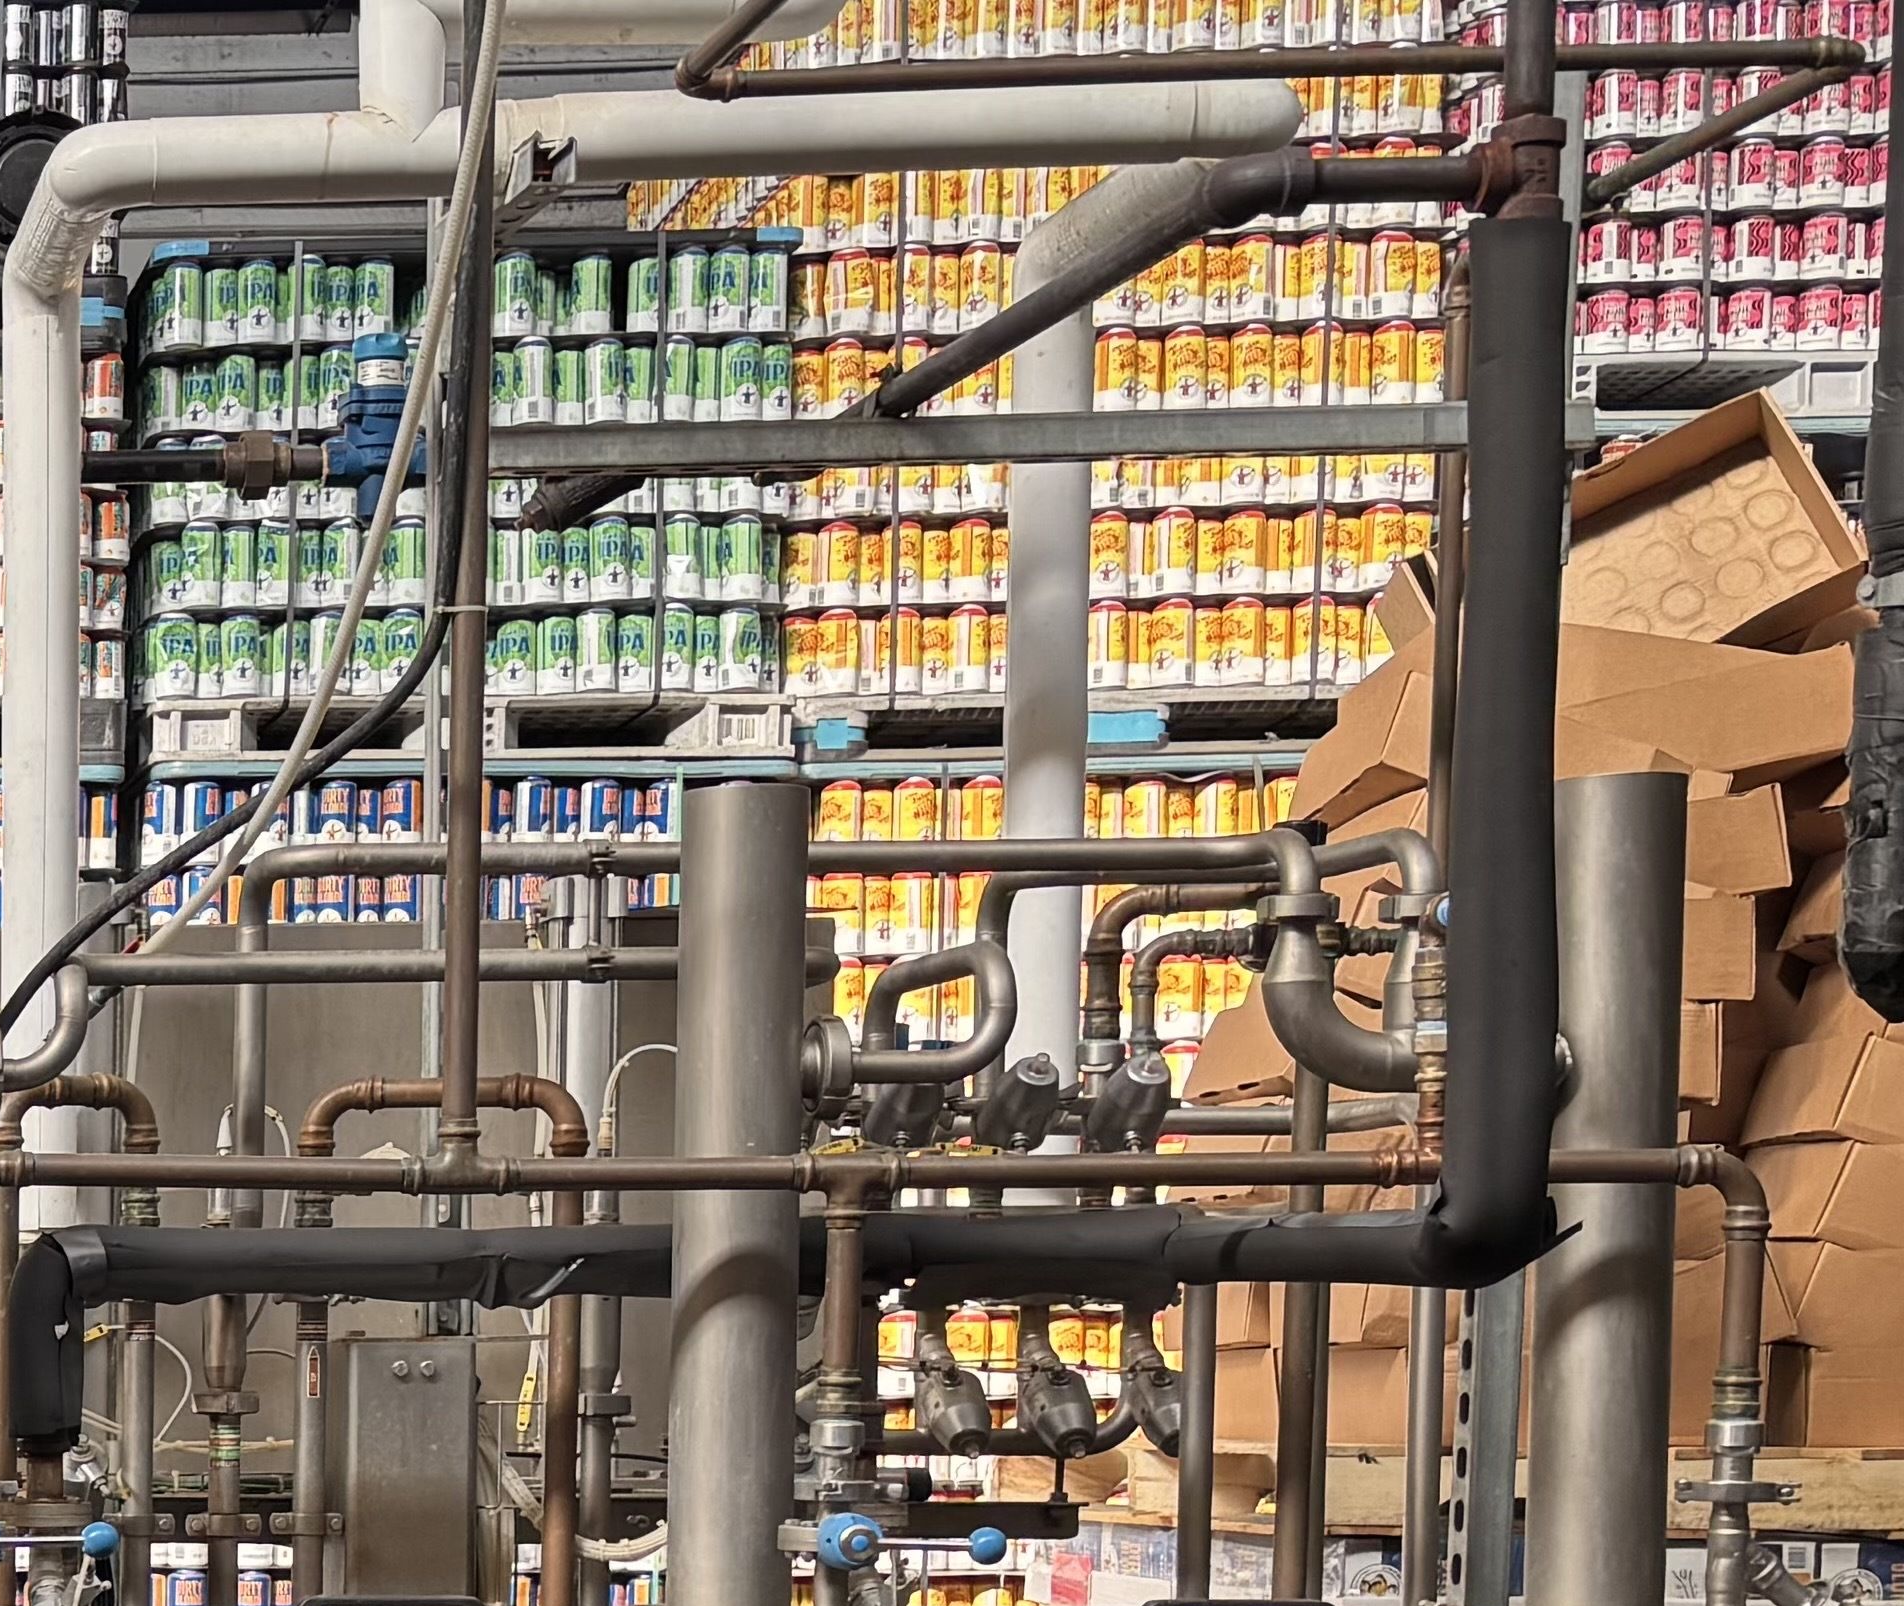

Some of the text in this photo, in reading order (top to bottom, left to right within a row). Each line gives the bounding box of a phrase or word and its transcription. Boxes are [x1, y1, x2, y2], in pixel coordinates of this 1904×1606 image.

[221, 281, 236, 300] IP
[765, 361, 786, 379] IP
[266, 377, 282, 395] IP
[258, 546, 277, 564] PA
[160, 556, 181, 576] IP
[354, 637, 376, 654] PA
[500, 636, 529, 654] IPA
[664, 629, 686, 647] PA
